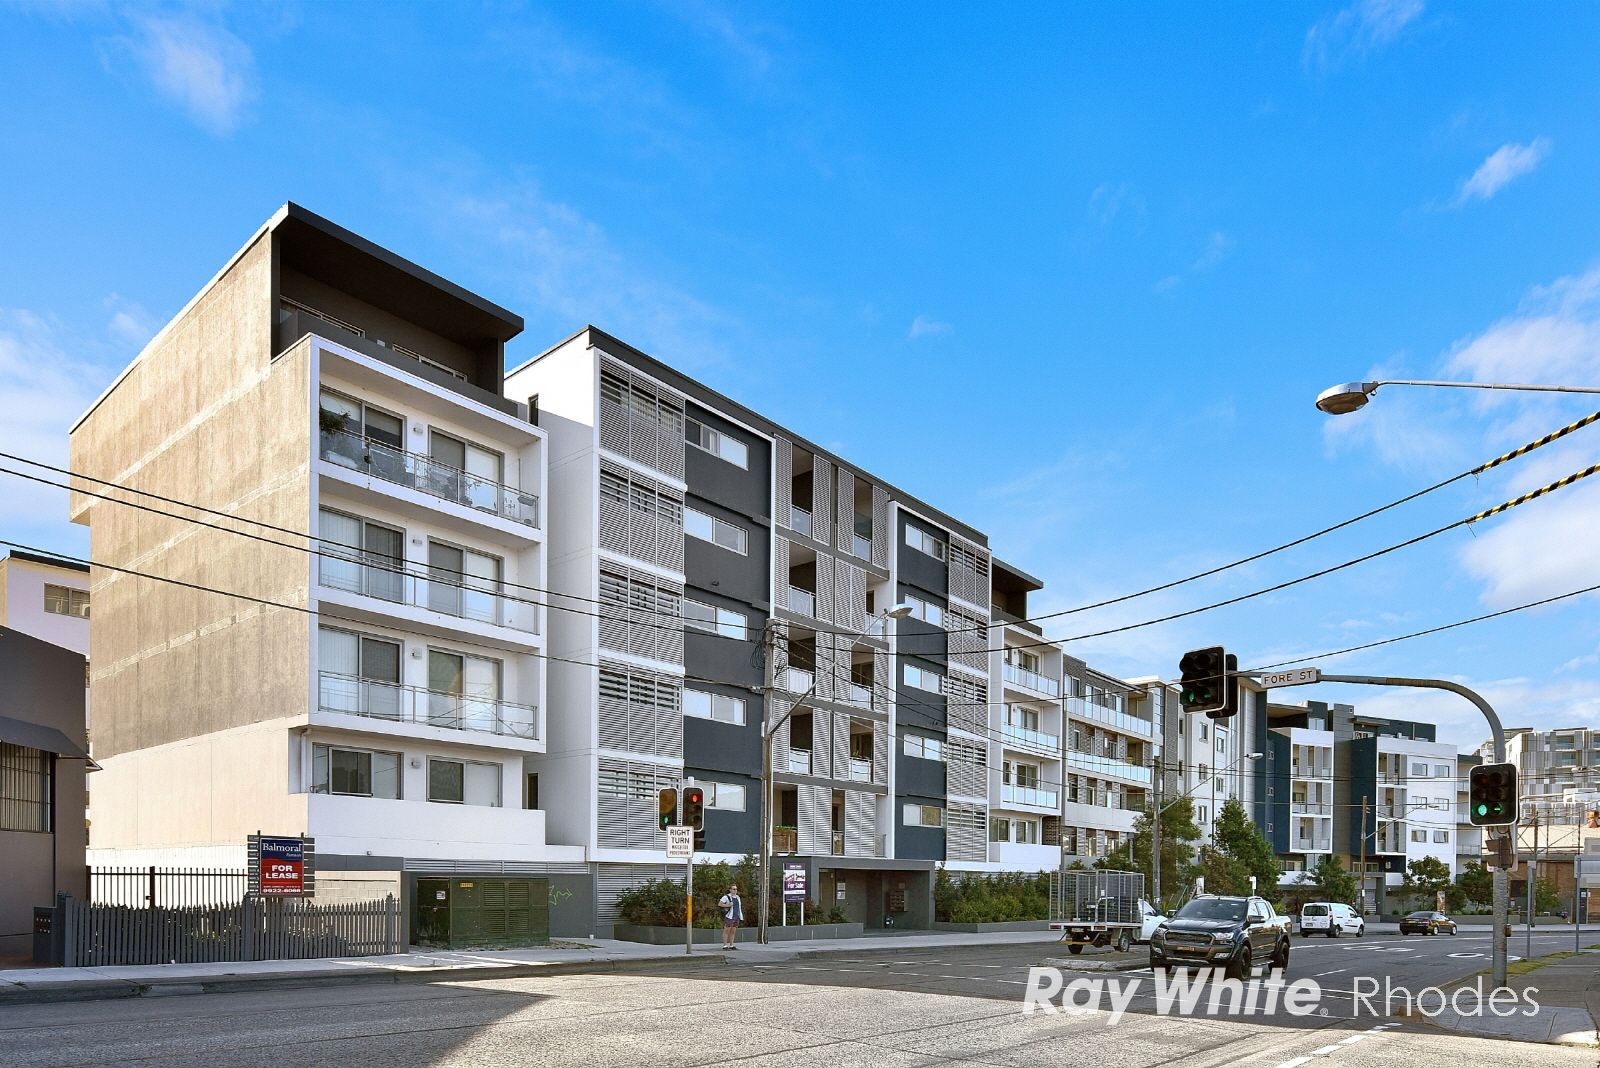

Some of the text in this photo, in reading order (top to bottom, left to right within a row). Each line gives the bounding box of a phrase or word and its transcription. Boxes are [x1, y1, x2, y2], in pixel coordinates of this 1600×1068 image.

[1264, 670, 1312, 685] FORE ST
[262, 843, 302, 852] Balmoral
[271, 864, 293, 872] FOR
